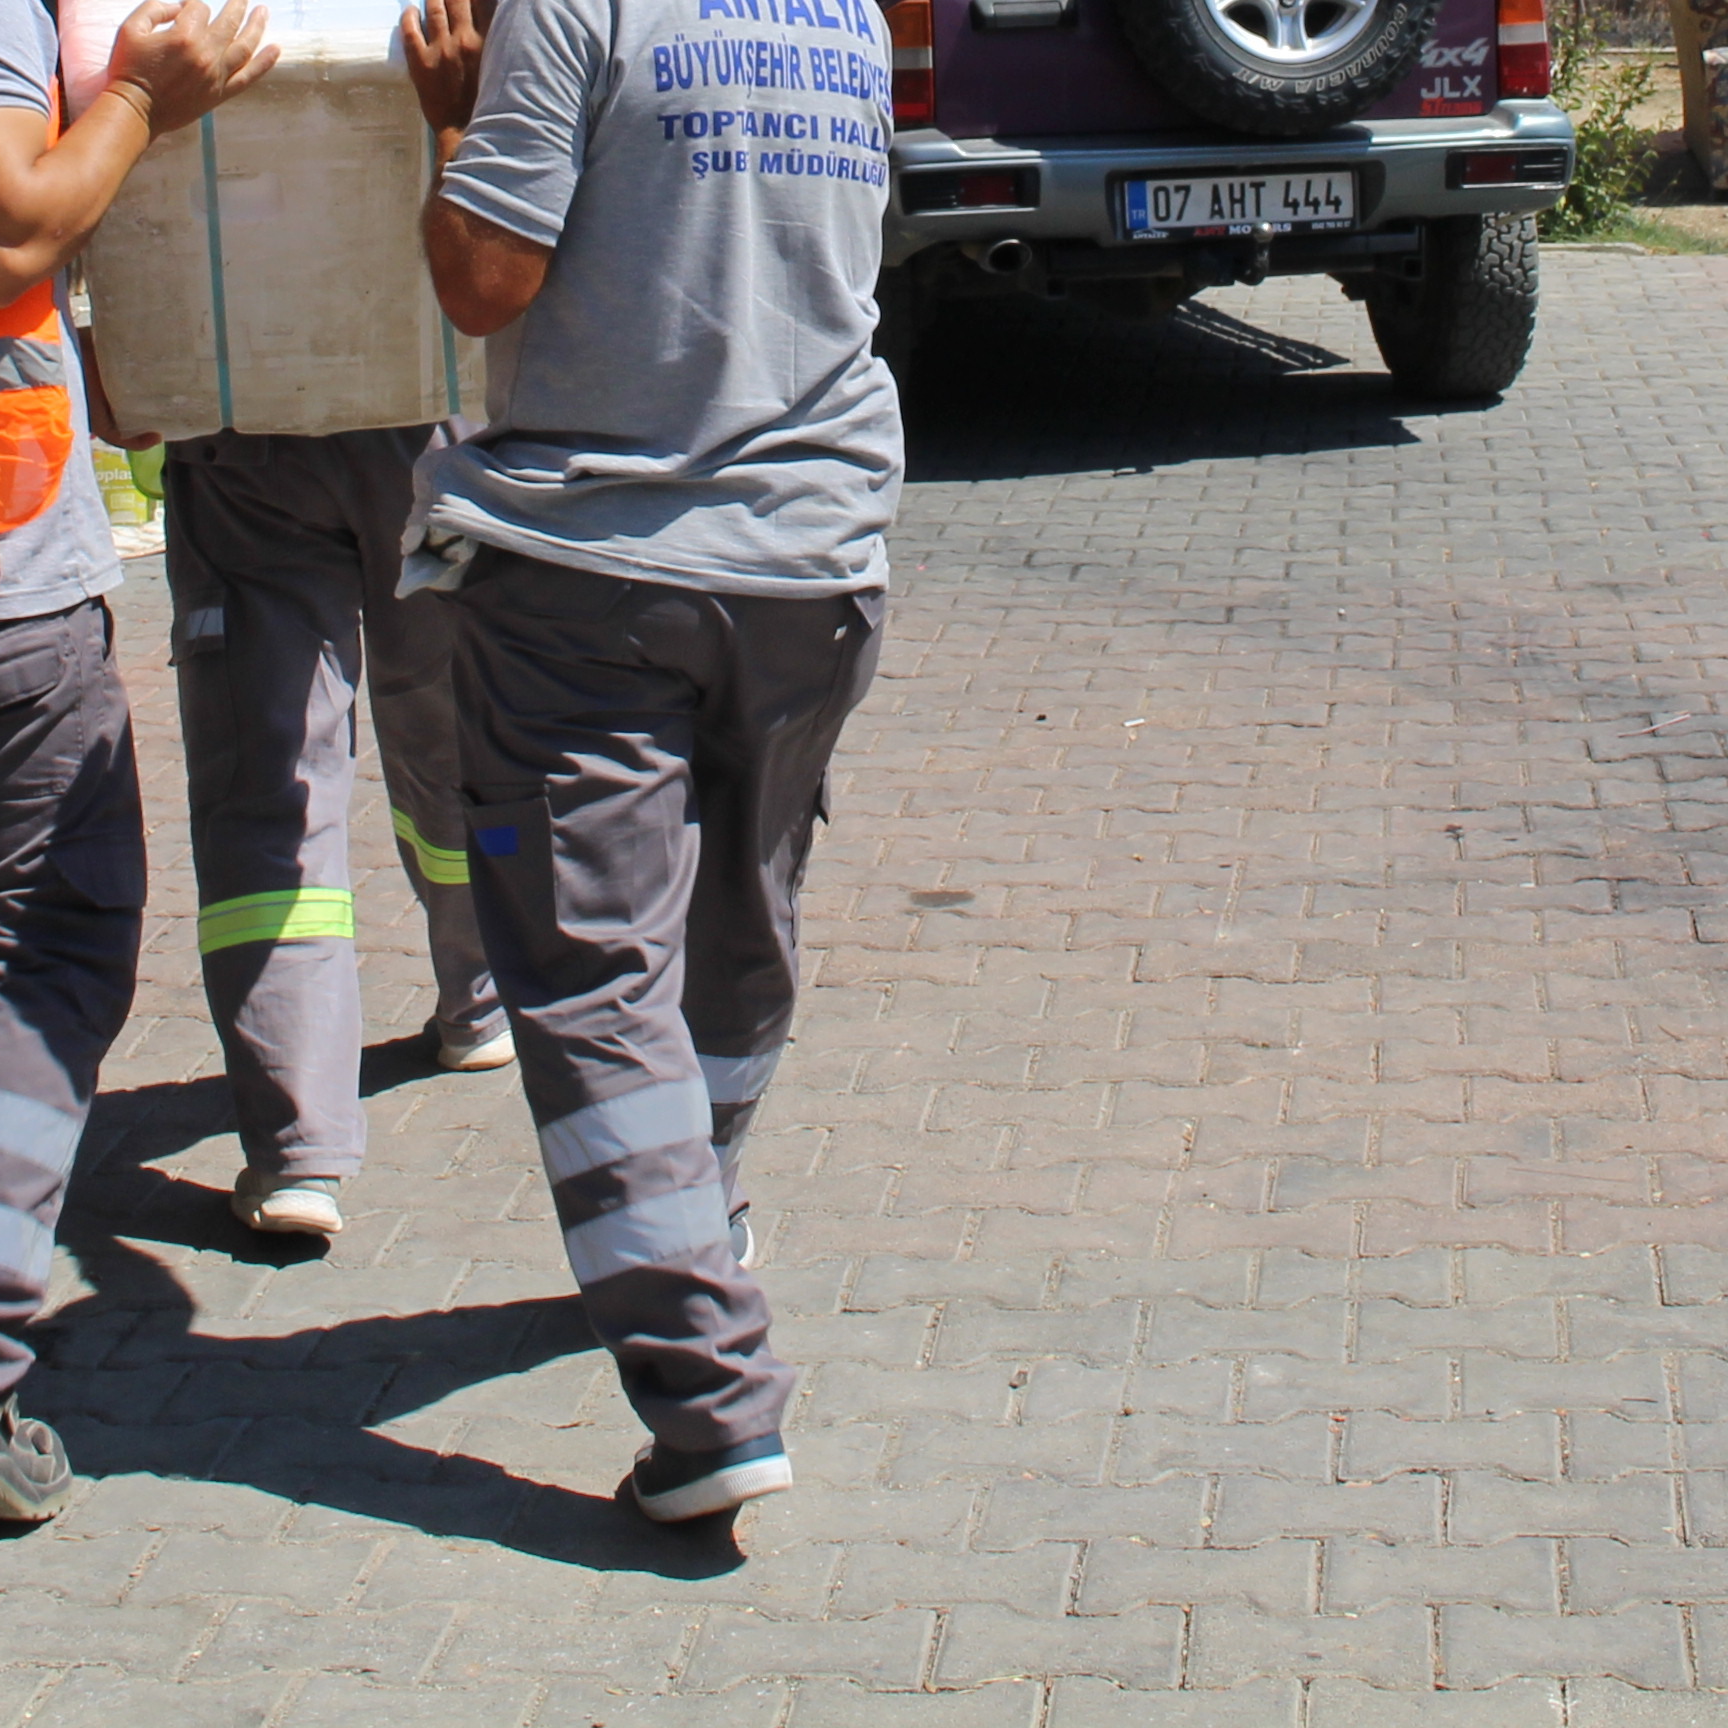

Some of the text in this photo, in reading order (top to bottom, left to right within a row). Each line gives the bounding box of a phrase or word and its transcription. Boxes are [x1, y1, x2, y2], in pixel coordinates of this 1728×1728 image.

[653, 30, 806, 98] BÜYÜKŞEHİR
[1421, 75, 1482, 98] JLX
[658, 110, 889, 154] TOPTANCI HALL
[692, 148, 888, 188] ŞUB MÜDÜRLÜĞÜ
[1132, 179, 1342, 222] TR 07 AHT 444
[1229, 223, 1292, 235] MORS
